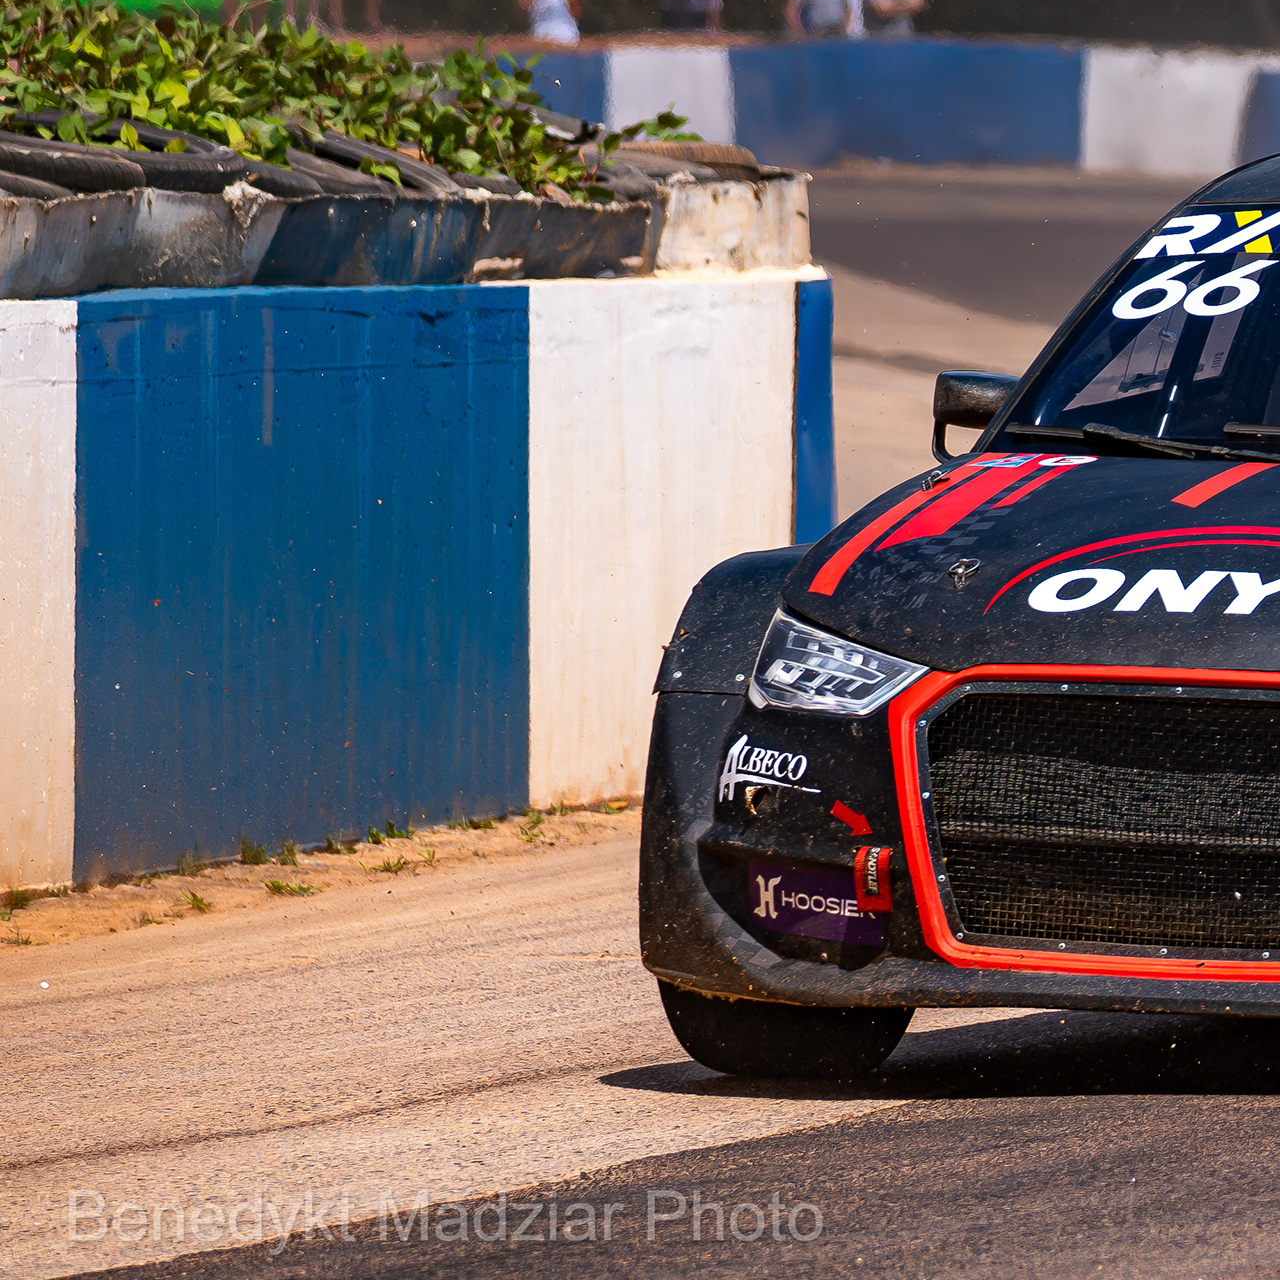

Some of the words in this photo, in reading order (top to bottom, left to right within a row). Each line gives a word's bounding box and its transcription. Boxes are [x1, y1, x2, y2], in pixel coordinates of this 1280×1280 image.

[1112, 260, 1280, 320] 66
[718, 734, 815, 803] ALBECO
[781, 890, 876, 919] HOOSIE
